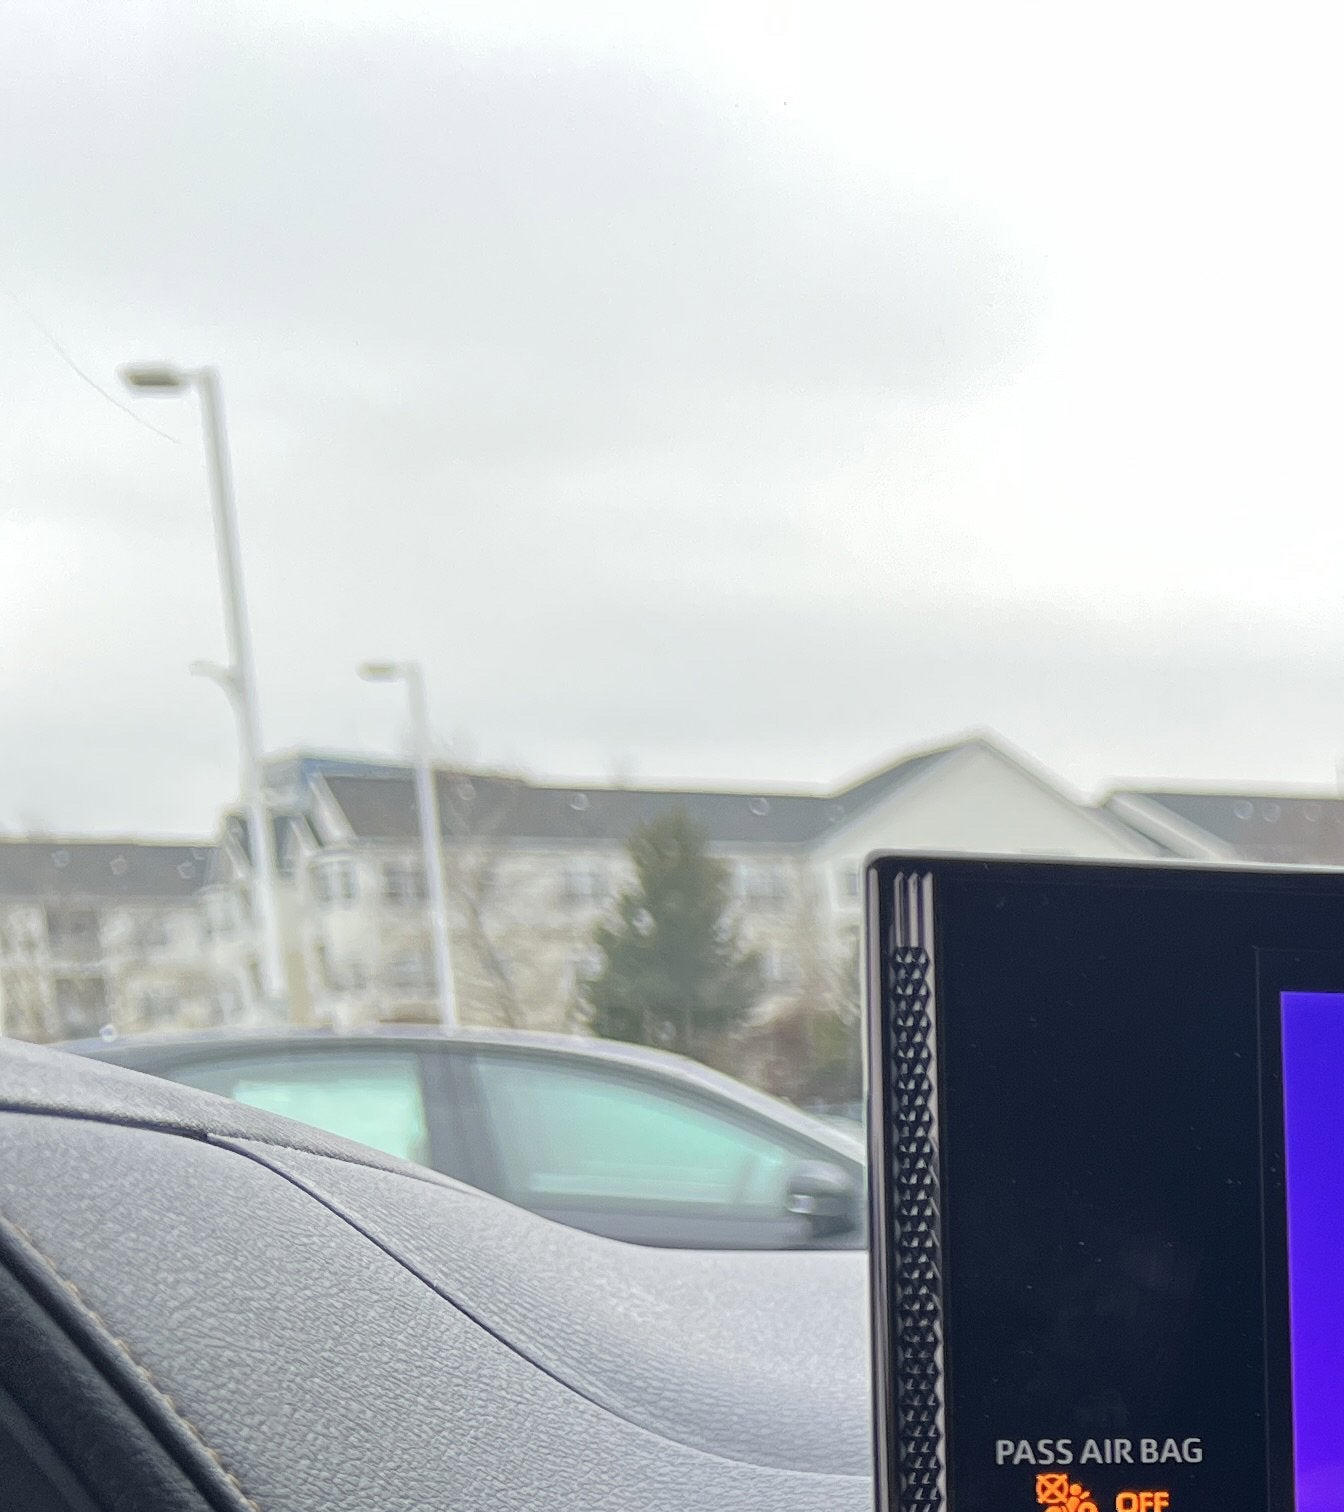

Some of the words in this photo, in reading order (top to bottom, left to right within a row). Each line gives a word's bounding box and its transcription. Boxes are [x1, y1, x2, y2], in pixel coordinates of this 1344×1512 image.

[995, 1438, 1073, 1466] PASS
[1080, 1438, 1133, 1465] AIR
[1141, 1437, 1203, 1464] BAG
